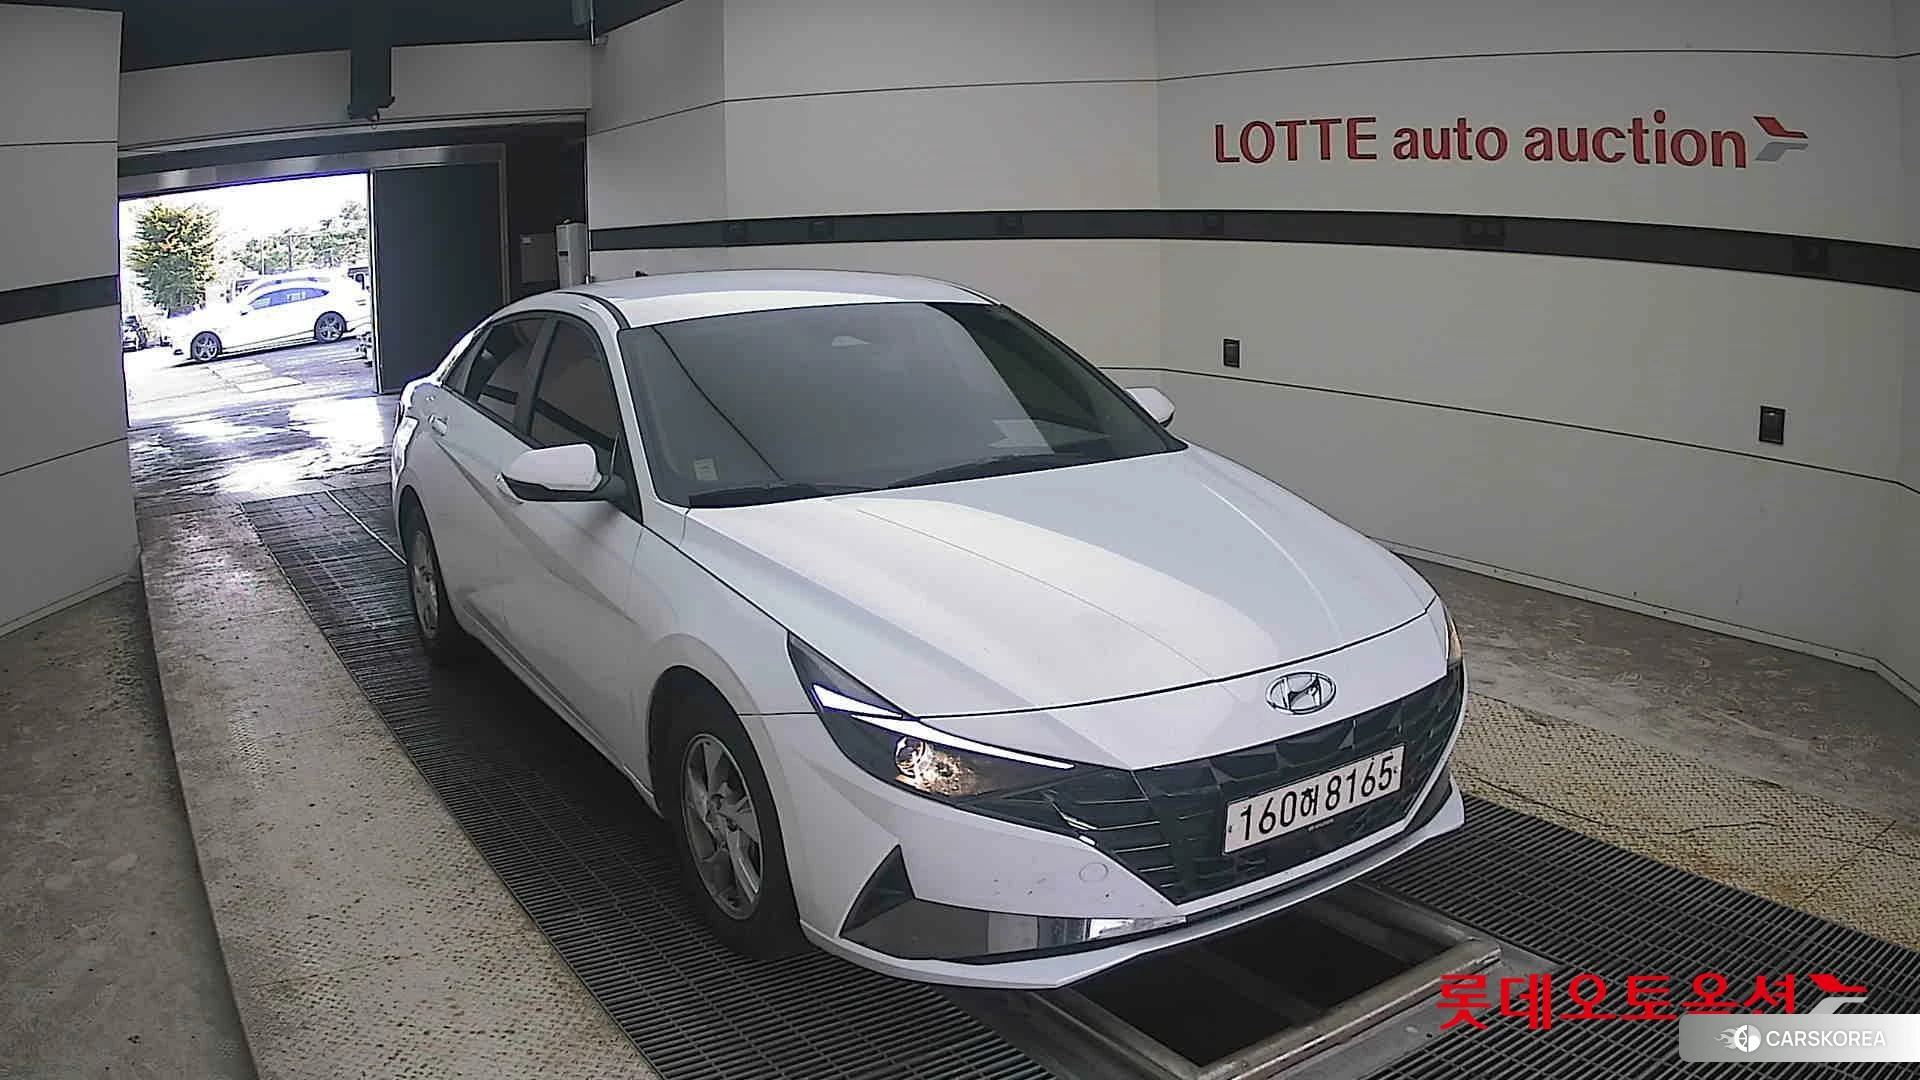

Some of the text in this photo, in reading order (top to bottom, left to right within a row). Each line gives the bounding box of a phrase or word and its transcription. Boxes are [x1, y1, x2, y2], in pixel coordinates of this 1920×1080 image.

[1215, 110, 1747, 168] LOTTE auto auction
